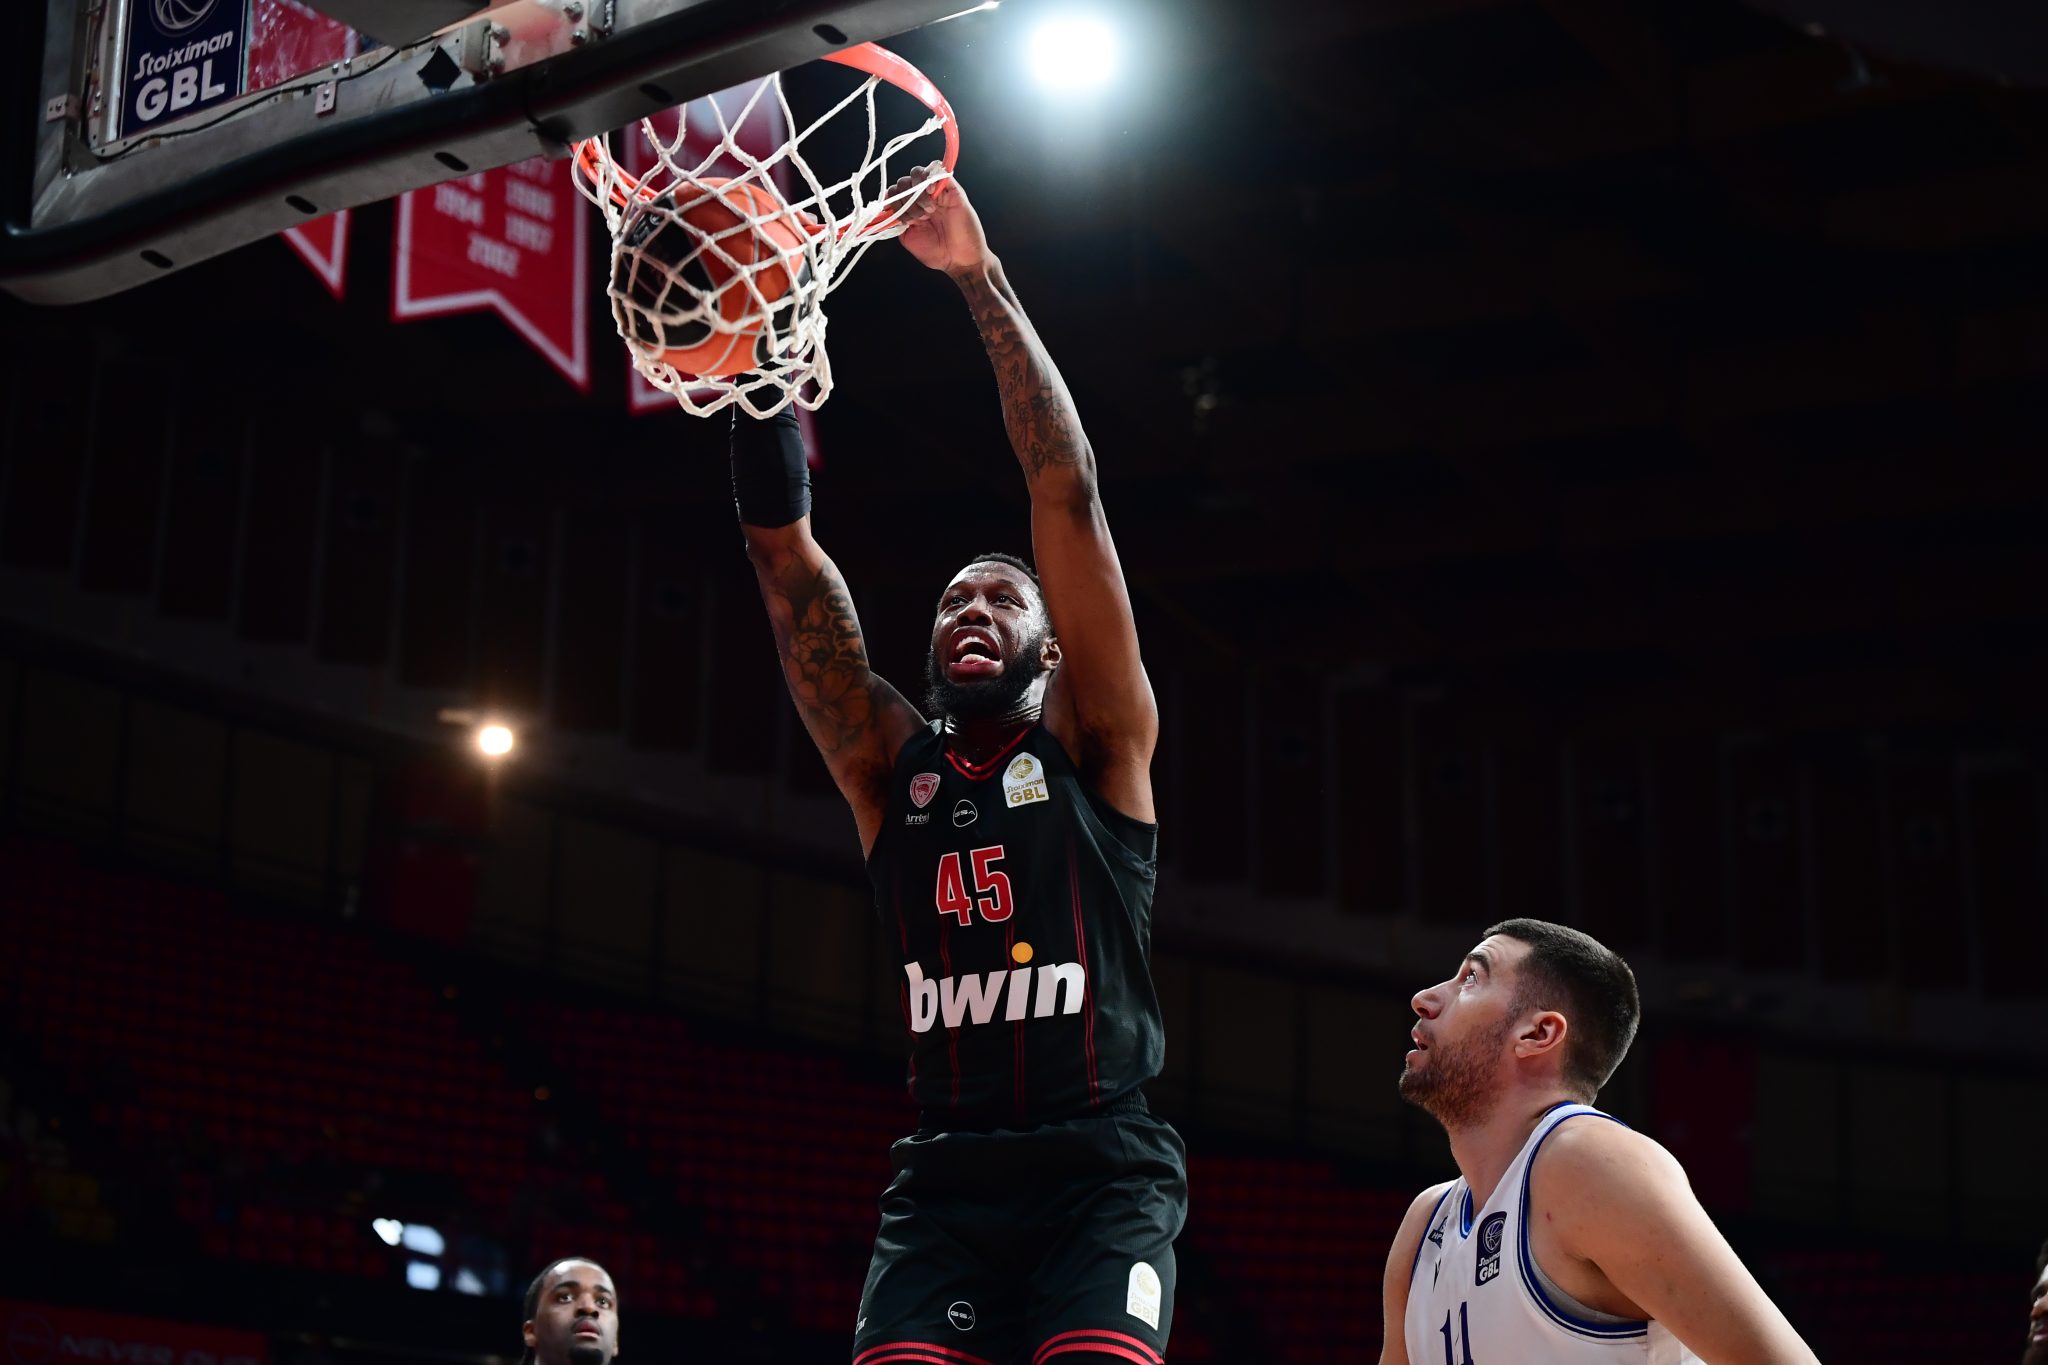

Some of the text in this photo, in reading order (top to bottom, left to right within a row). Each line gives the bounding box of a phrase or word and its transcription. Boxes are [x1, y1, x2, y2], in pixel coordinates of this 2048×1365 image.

[133, 30, 234, 81] Stoiximan
[135, 59, 226, 122] GBL
[1006, 778, 1045, 794] Stoiximan
[1010, 786, 1046, 804] GBL
[935, 844, 1014, 927] 45
[904, 941, 1086, 1033] bwin
[1479, 1259, 1500, 1282] GBL
